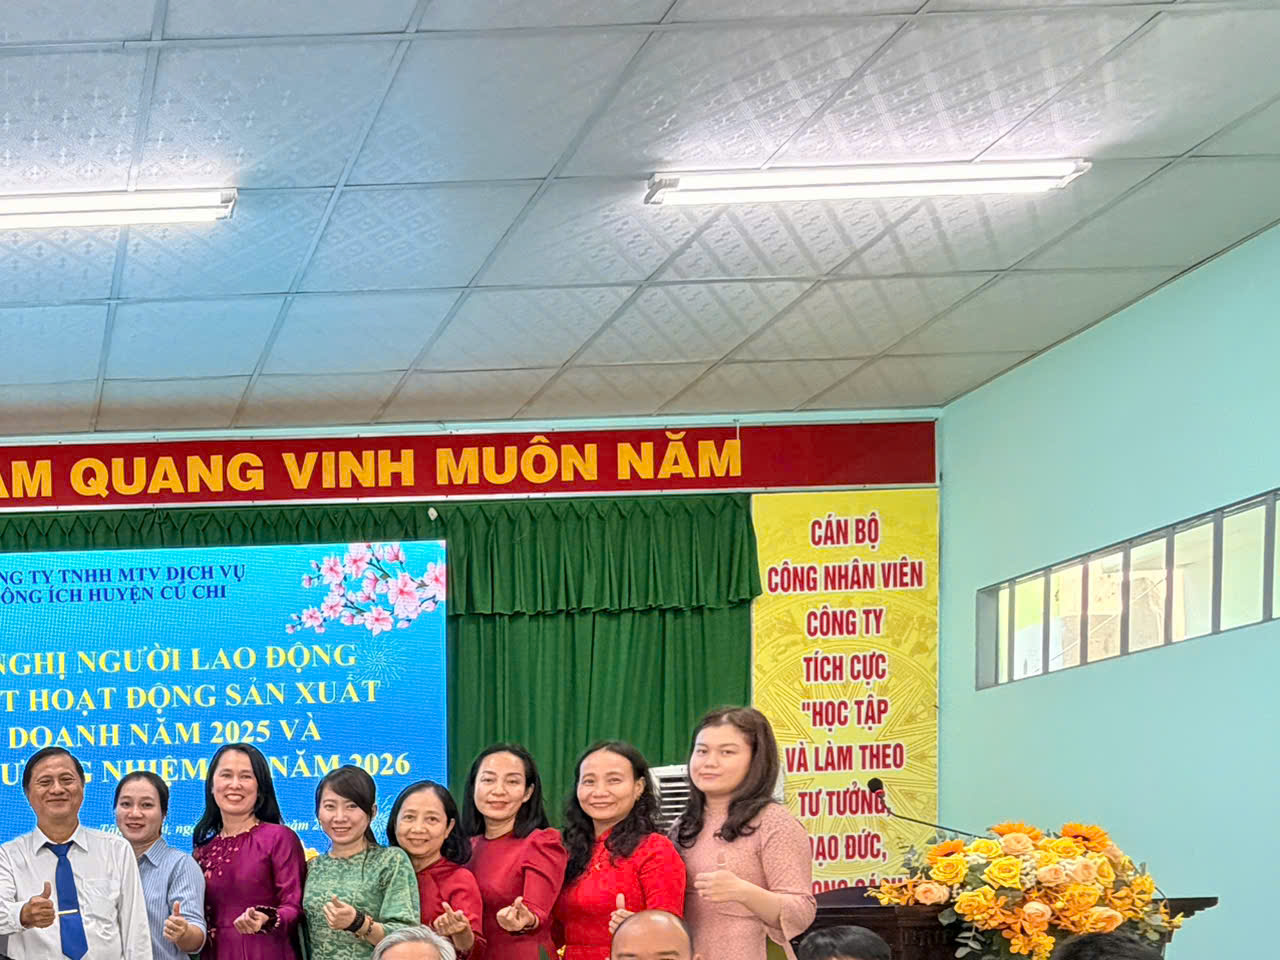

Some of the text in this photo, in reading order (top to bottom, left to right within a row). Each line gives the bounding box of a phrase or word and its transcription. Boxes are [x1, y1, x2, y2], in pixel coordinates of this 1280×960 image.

[70, 452, 264, 498] QUANG
[282, 449, 414, 490] VINH
[436, 435, 597, 485] MUÔN
[617, 431, 741, 480] NĂM
[811, 512, 879, 549] CÁN BỘ
[28, 569, 54, 584] TY
[58, 567, 112, 583] TNHH
[117, 566, 161, 582] MTV
[166, 565, 214, 584] DỊCH
[220, 564, 246, 583] VỤ
[767, 556, 923, 593] CÔNG NHÂN VIÊN
[48, 585, 82, 603] ÍCH
[88, 584, 154, 605] HUYỆN
[192, 584, 227, 599] CHI
[807, 605, 884, 637] CÔNG TY
[77, 643, 181, 674] NGƯỜI
[191, 647, 256, 671] LAO
[266, 642, 357, 673] ĐỘNG
[803, 650, 887, 685] TÍCH CỰC
[28, 687, 118, 716] HOẠT
[125, 682, 217, 714] ĐỘNG
[225, 677, 285, 707] SẢN
[294, 673, 381, 704] XUẤT
[8, 724, 121, 748] DOANH
[129, 717, 200, 745] NĂM
[209, 720, 270, 744] 2025
[278, 712, 322, 741] VÀ
[802, 694, 889, 732] "HỌC TẬP
[785, 741, 905, 772] VÀ LÀM THEO
[798, 788, 822, 817] TƯ
[845, 828, 887, 862] ĐỨC,
